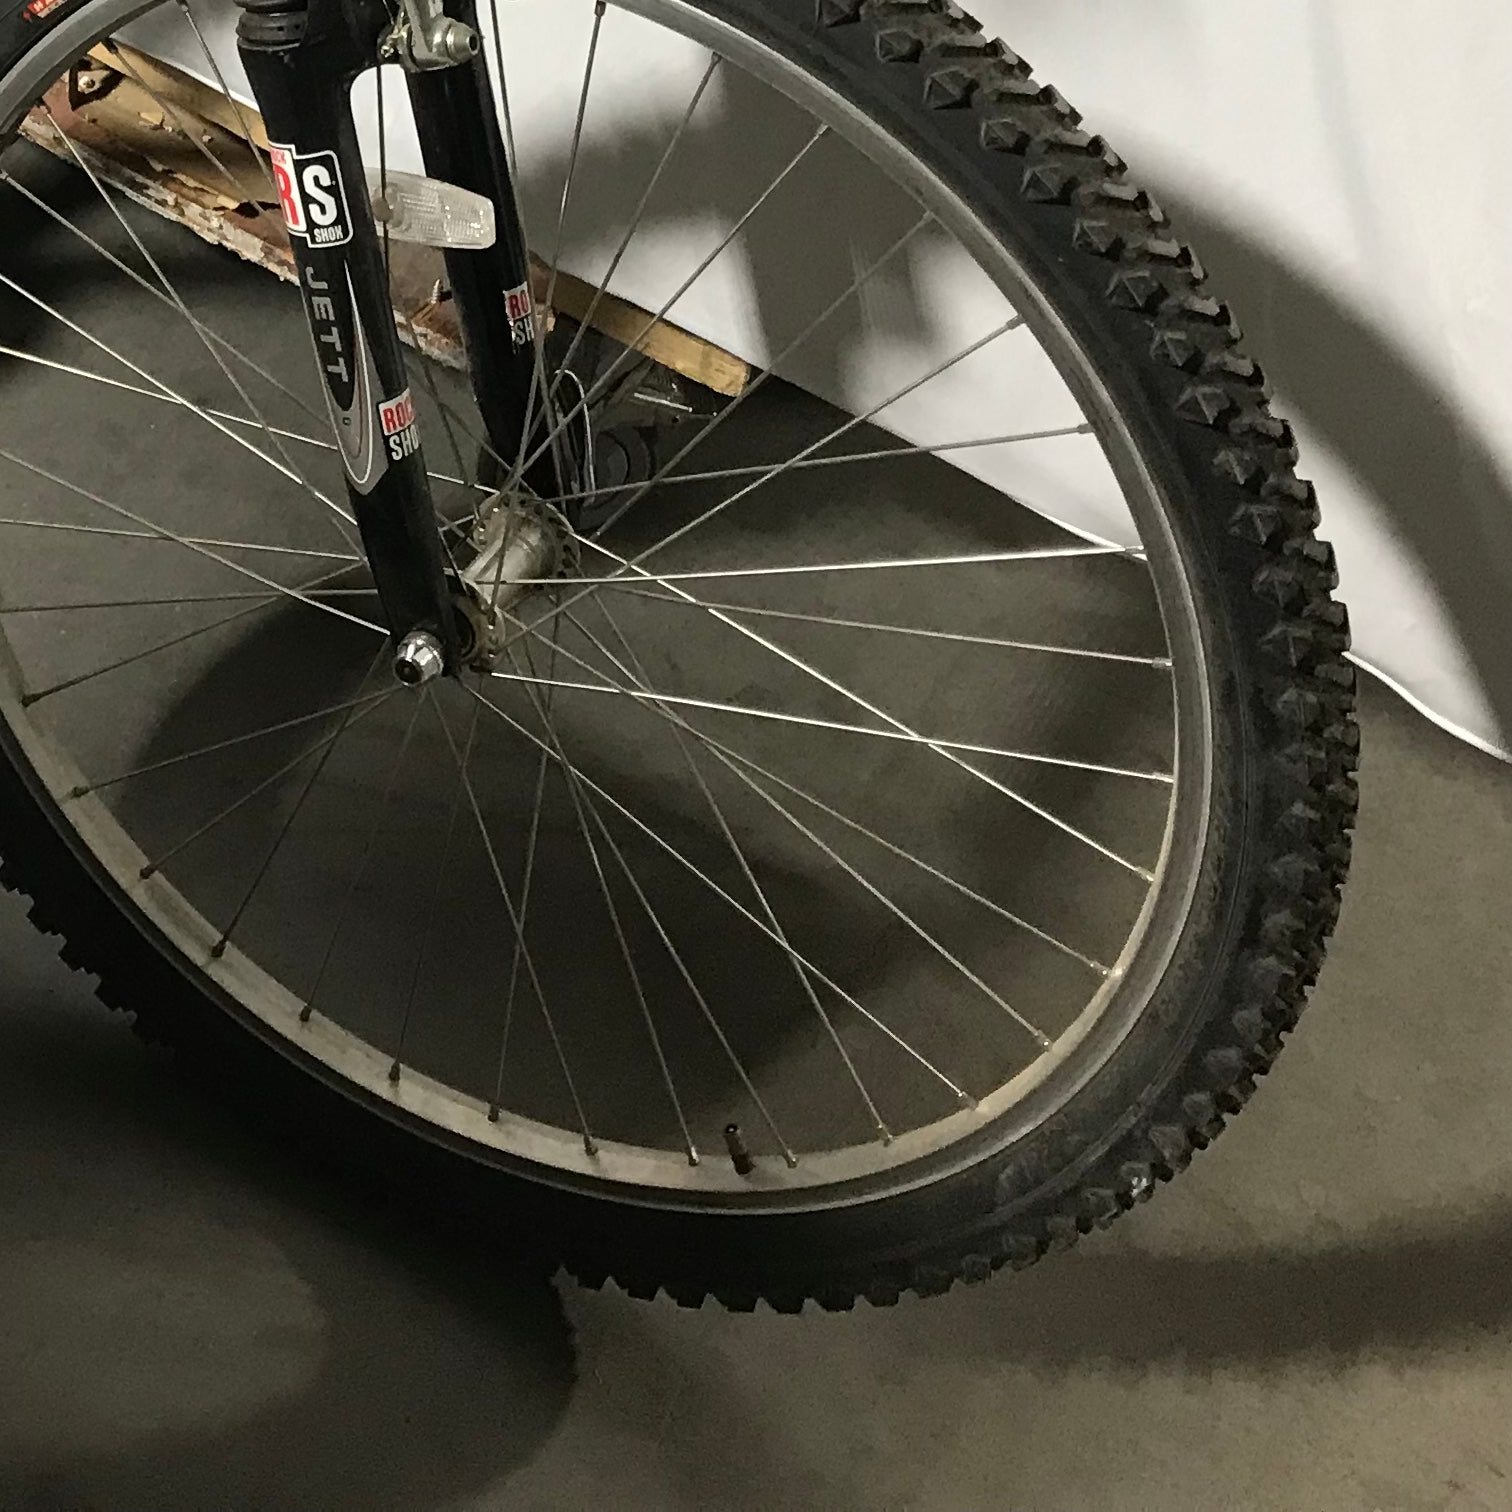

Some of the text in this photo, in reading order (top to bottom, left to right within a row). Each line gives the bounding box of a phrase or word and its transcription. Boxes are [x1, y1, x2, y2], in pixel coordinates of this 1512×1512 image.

[313, 225, 344, 243] SHOX
[508, 290, 530, 319] RO
[305, 266, 349, 383] JETT
[514, 315, 535, 345] SH
[382, 395, 416, 433] ROC
[389, 424, 421, 461] SHO
